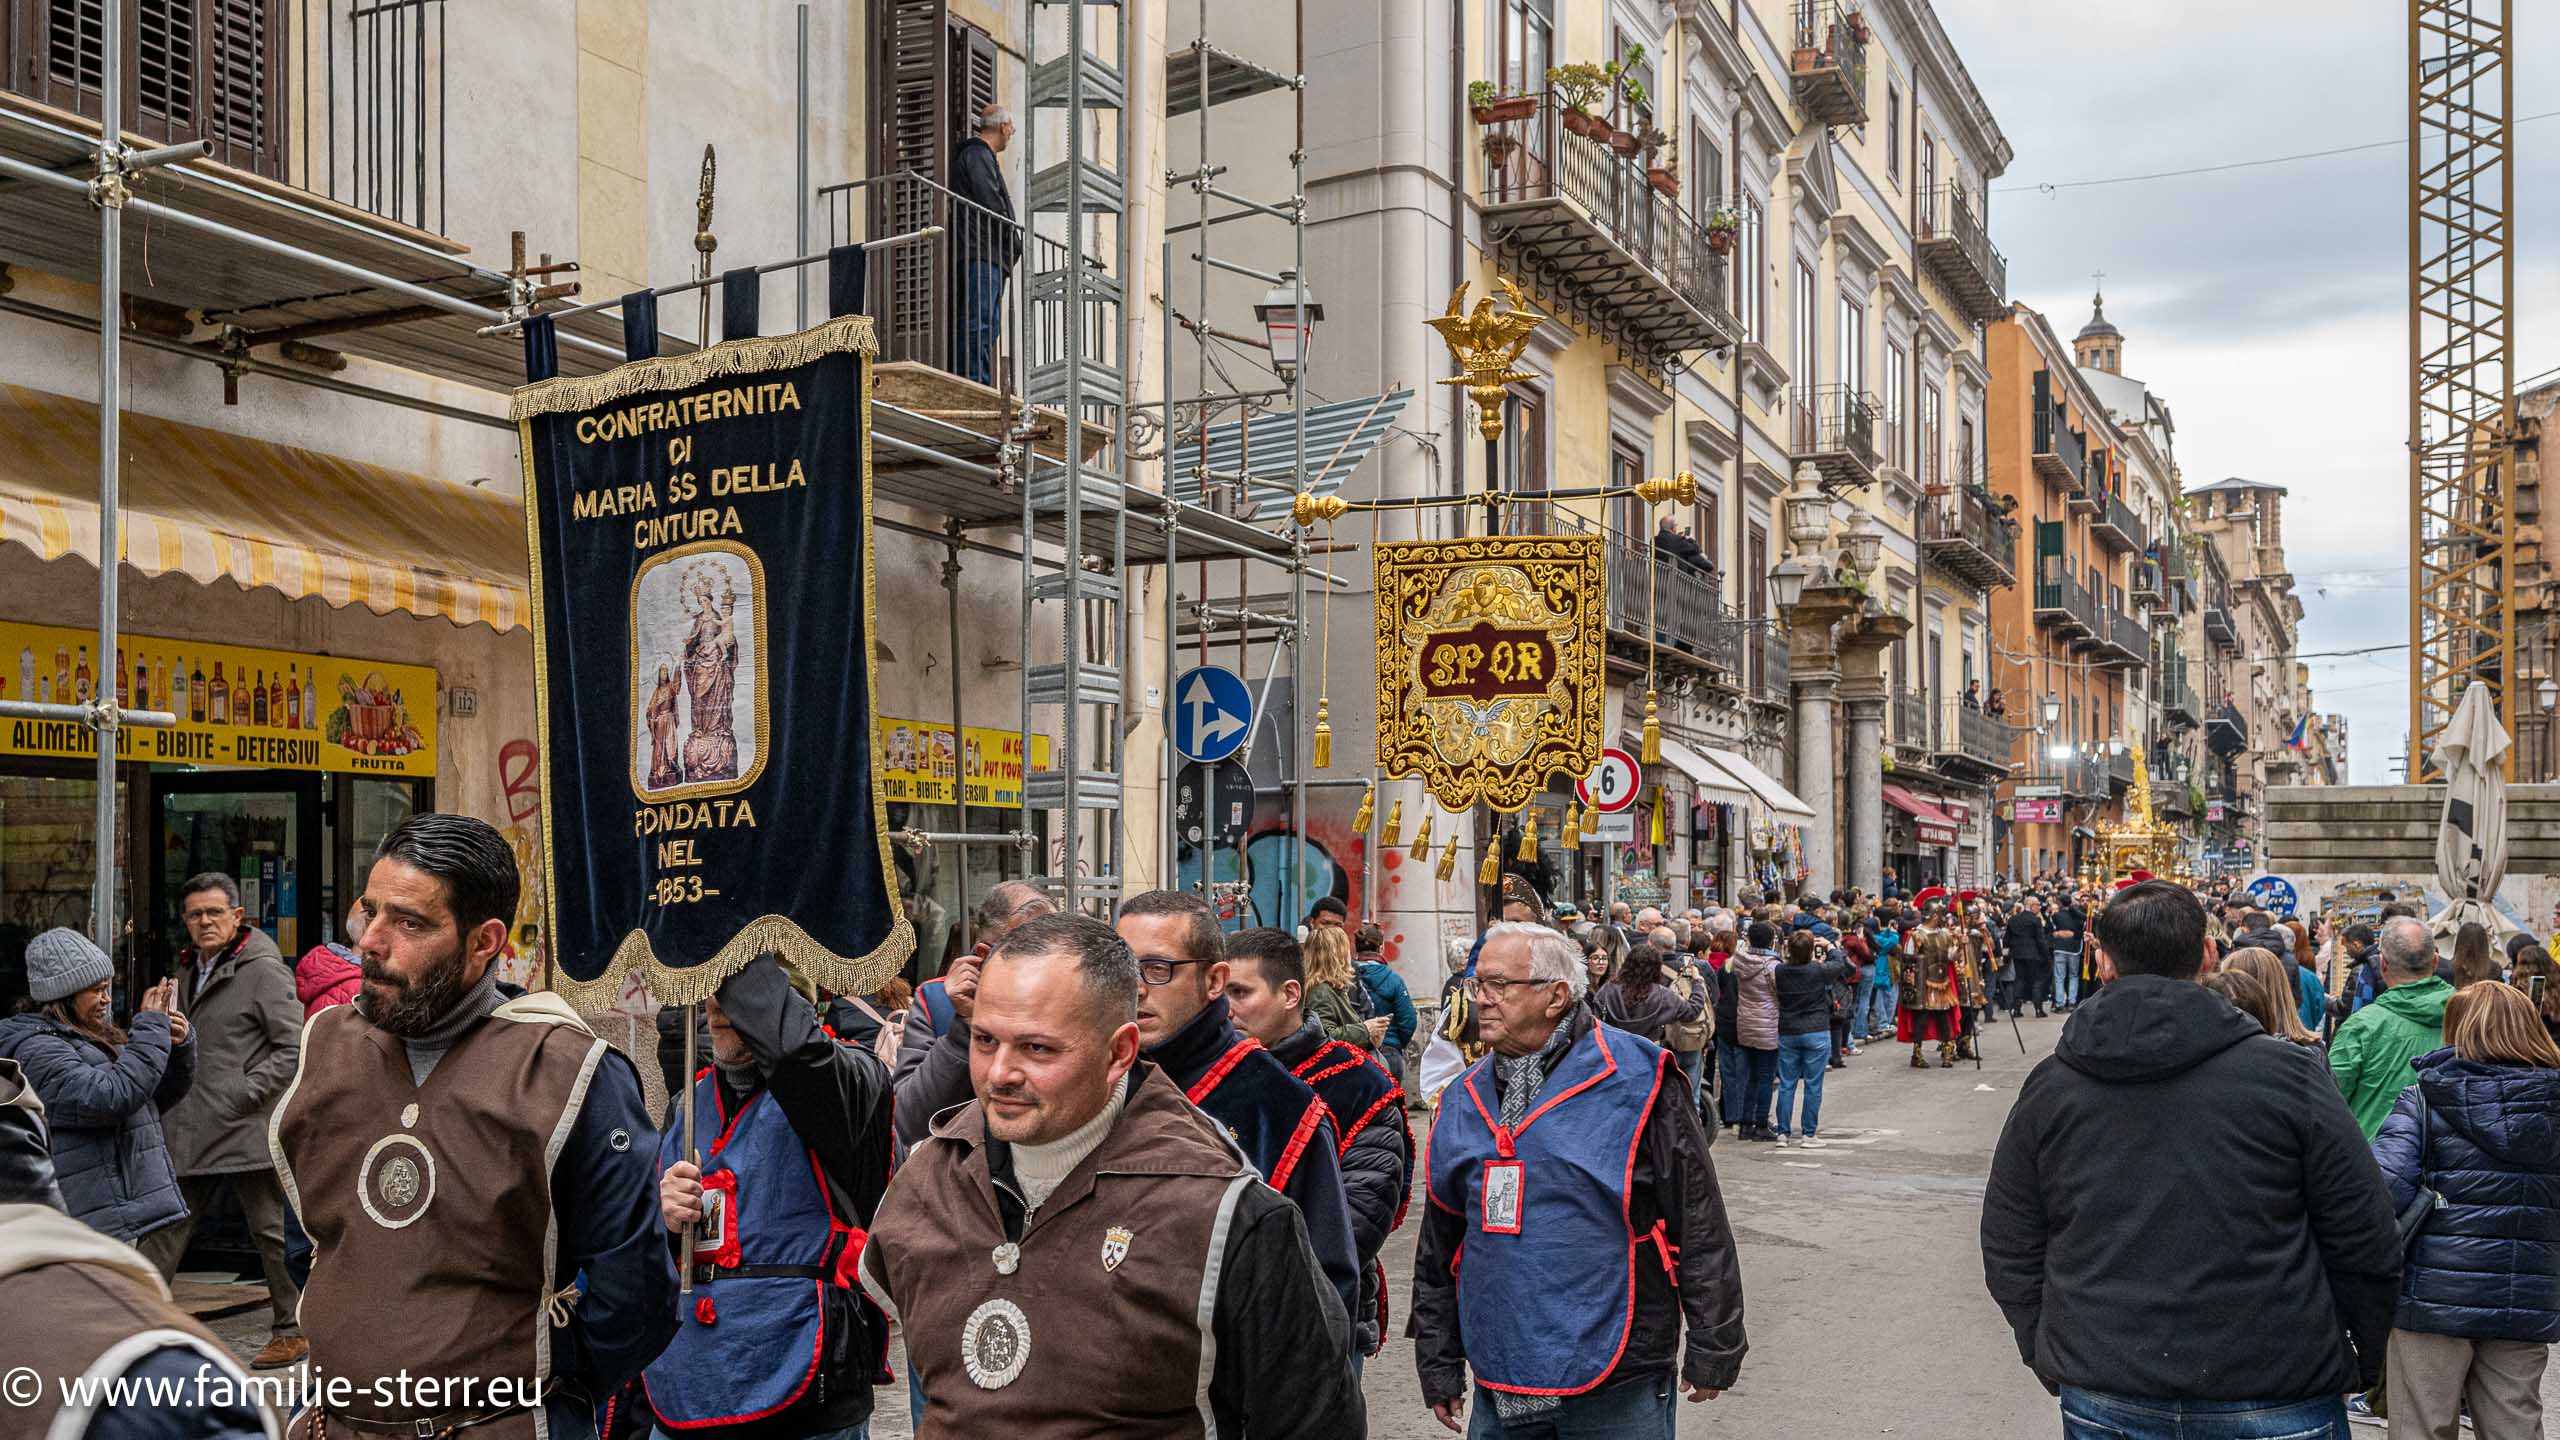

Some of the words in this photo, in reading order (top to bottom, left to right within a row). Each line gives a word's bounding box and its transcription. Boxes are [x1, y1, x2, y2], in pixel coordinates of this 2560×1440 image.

[575, 381, 801, 445] CONFRATERNITA
[668, 434, 692, 467] DI
[573, 479, 656, 520] MARIA
[668, 473, 698, 504] SS
[711, 458, 806, 497] DELLA
[634, 505, 743, 550] CINTURA
[12, 720, 132, 755] ALIMENTRI
[156, 730, 215, 760] BIBITE
[236, 735, 320, 766] DETERSIVI
[351, 758, 405, 771] FRUTTA
[1601, 765, 1615, 795] 6
[916, 781, 942, 800] BIBITE
[634, 799, 756, 838] FONDATA
[657, 839, 703, 870] NEL
